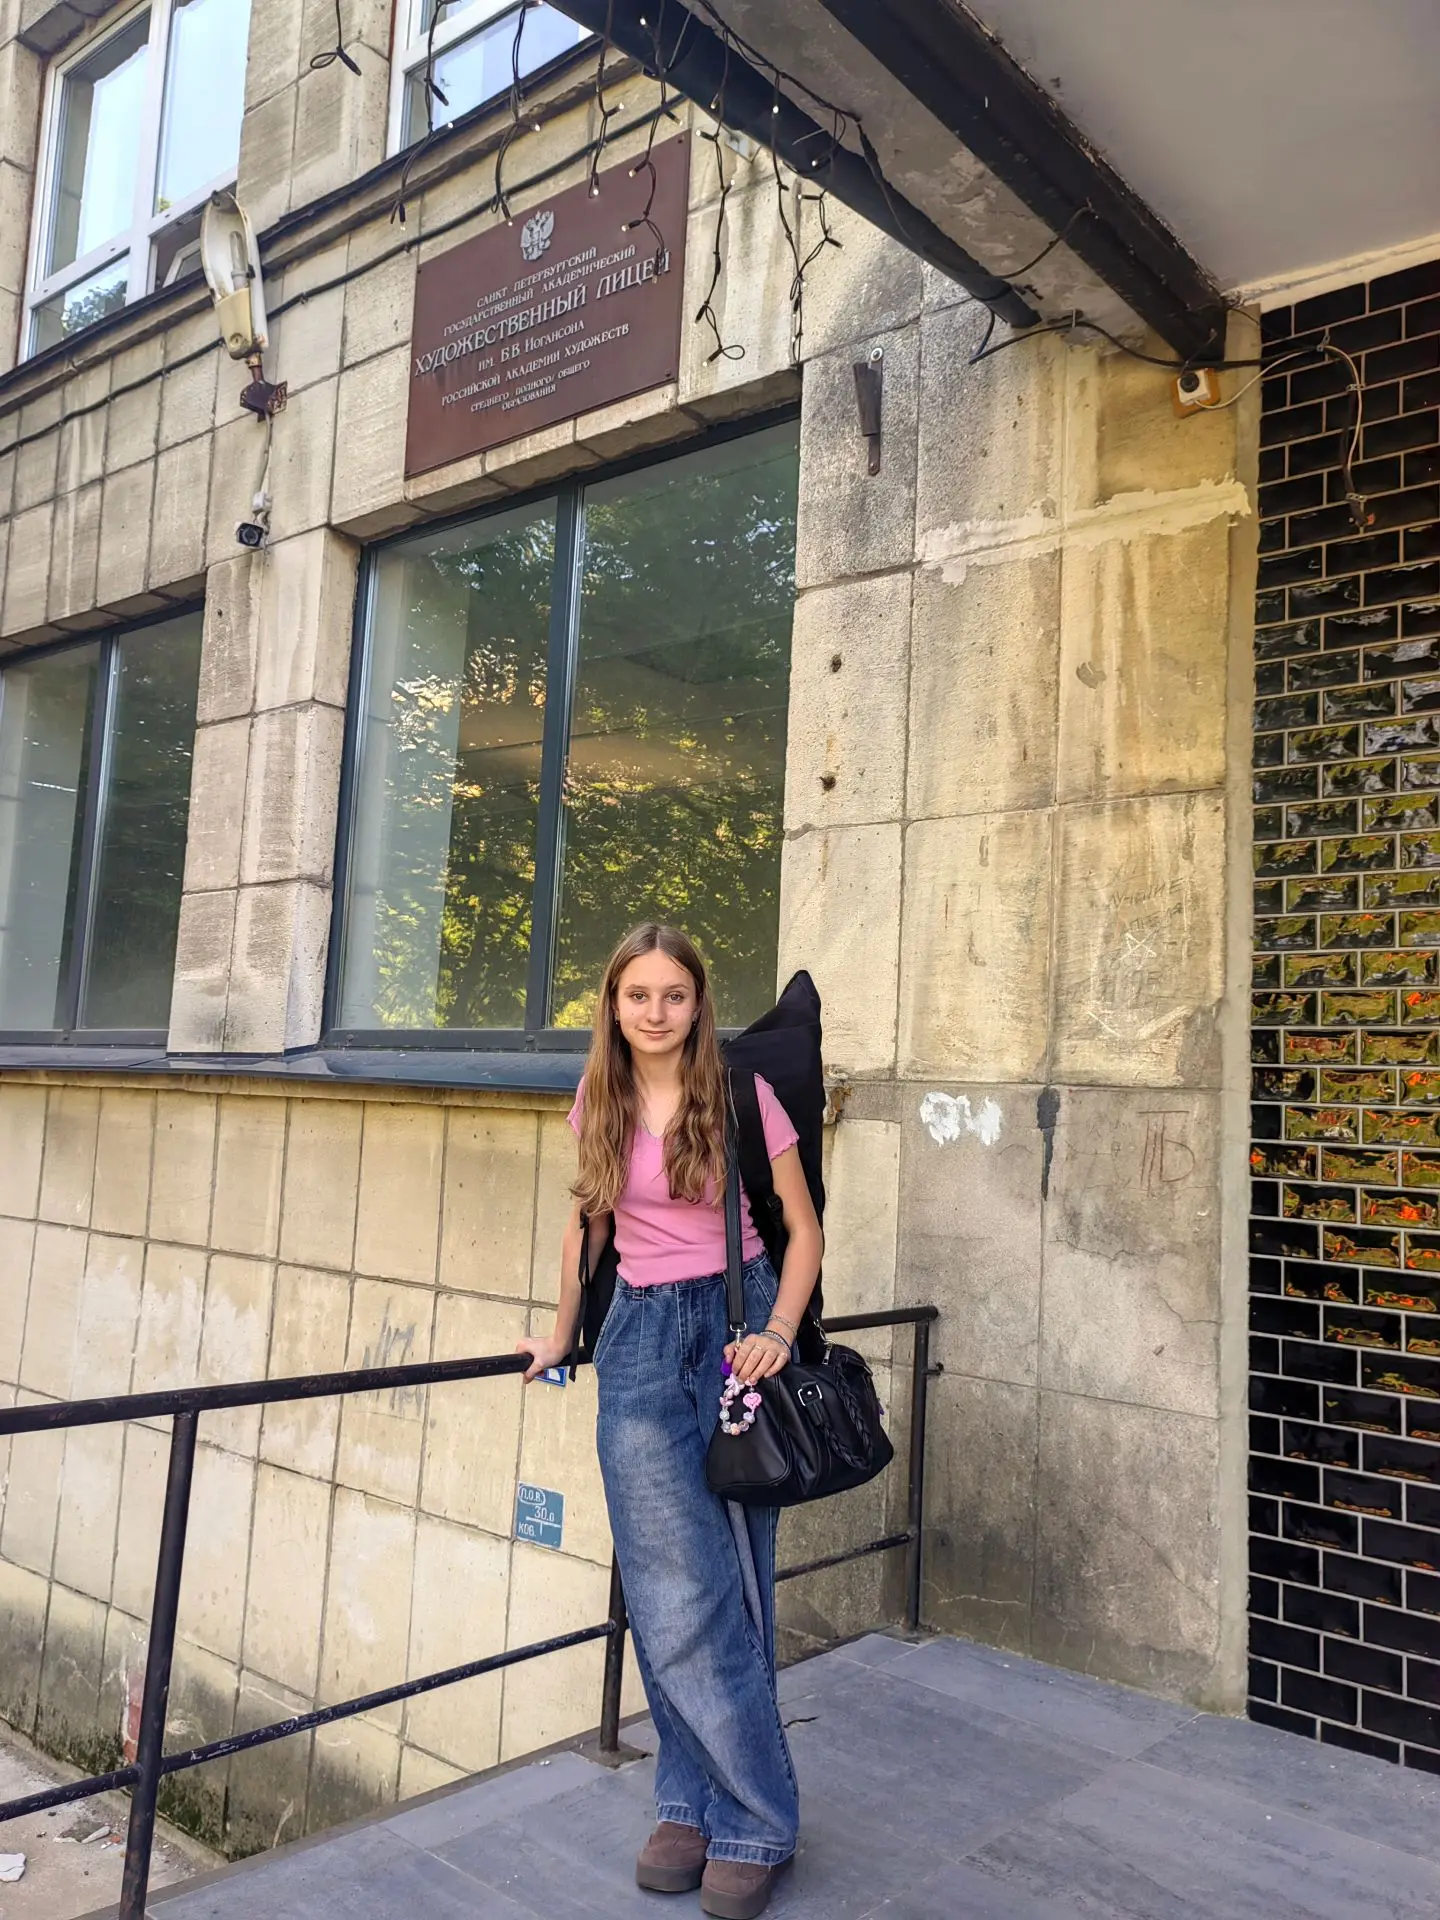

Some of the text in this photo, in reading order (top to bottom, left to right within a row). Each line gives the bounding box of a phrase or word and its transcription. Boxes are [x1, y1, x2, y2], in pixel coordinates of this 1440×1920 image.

[414, 283, 587, 377] ХУДОЖЕСТВЕННЫЙ
[443, 244, 636, 337] ГОСУДАРСТВЕННЫЙ АКАДЕМИЧЕСКИЙ
[441, 323, 630, 407] РОССИЙСКОЙ АКАДЕМИИ ХУДОЖЕСТВ
[501, 384, 556, 411] ОБРАЗОВАНИЯ
